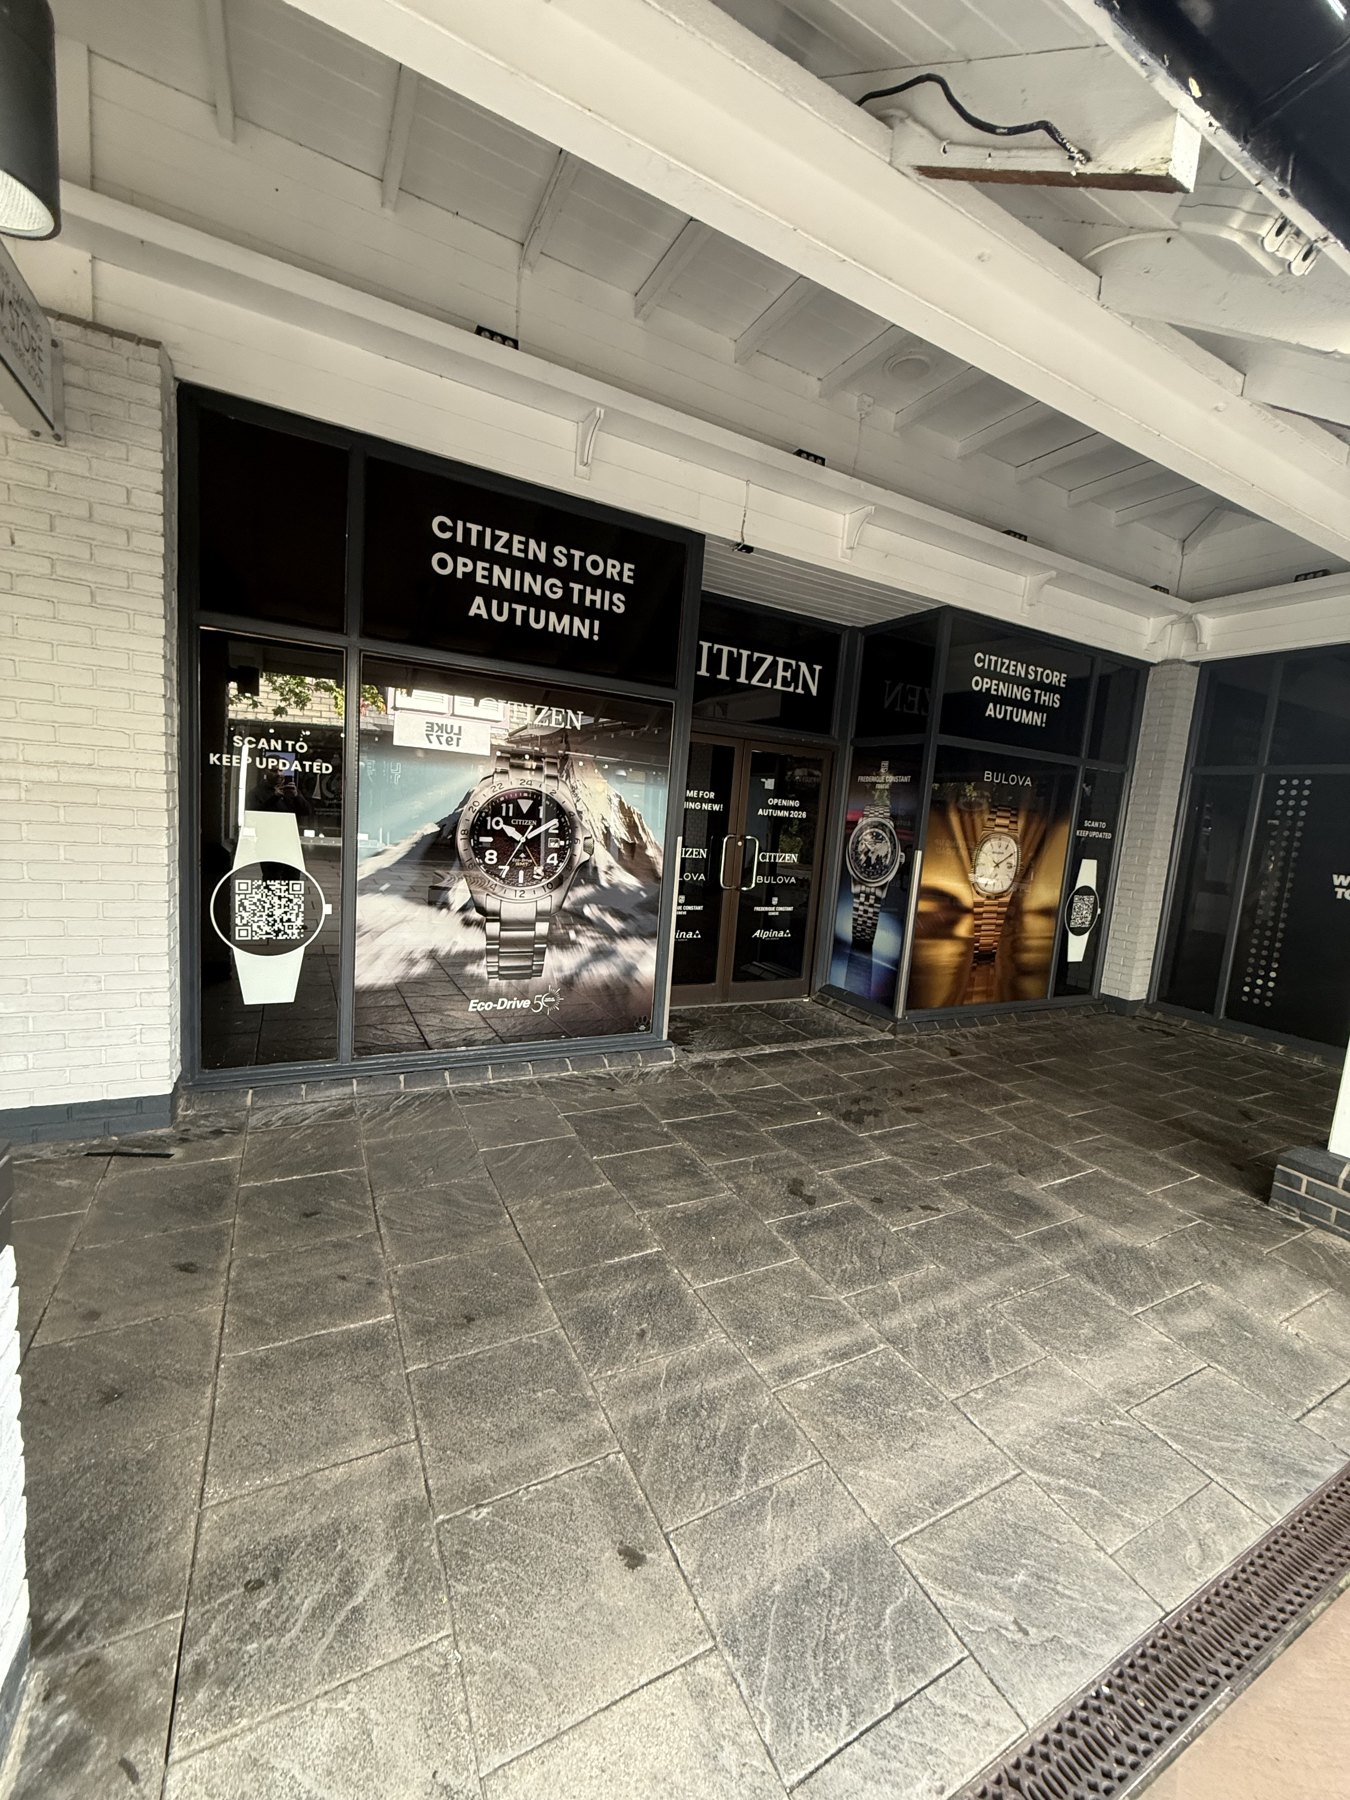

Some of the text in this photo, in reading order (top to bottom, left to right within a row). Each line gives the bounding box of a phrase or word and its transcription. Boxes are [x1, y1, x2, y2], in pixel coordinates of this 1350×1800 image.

[431, 515, 636, 585] CITIZEN STORE
[431, 552, 626, 614] OPENING THIS
[468, 595, 600, 641] AUTUMN!
[696, 640, 823, 696] ITIZEN
[973, 652, 1068, 689] CITIZEN STORE
[971, 675, 1061, 708] OPENING THIS
[478, 696, 585, 731] TIZEN
[985, 702, 1048, 728] AUTUMN!
[233, 735, 308, 753] SCAN TO
[209, 753, 333, 774] KEEP UPDATED
[519, 779, 533, 787] 24
[984, 771, 1033, 787] BULOVA
[490, 782, 505, 793] 22
[686, 789, 715, 799] ME FOR
[468, 800, 480, 814] 20
[701, 802, 723, 811] NEW!
[767, 798, 800, 807] OPENING
[501, 803, 514, 817] 11
[757, 808, 789, 818] AUTUMN
[486, 816, 504, 831] 10
[510, 818, 537, 826] CITIZEN
[484, 849, 498, 865] 8
[546, 852, 559, 866] 4
[681, 847, 708, 859] IZEN
[758, 852, 799, 863] CITIZEN
[498, 865, 510, 879] 7
[756, 875, 797, 884] BULOVA
[514, 889, 526, 898] 12
[675, 929, 693, 939] ina
[751, 929, 784, 940] Alpina
[467, 998, 531, 1012] Eco-Drive
